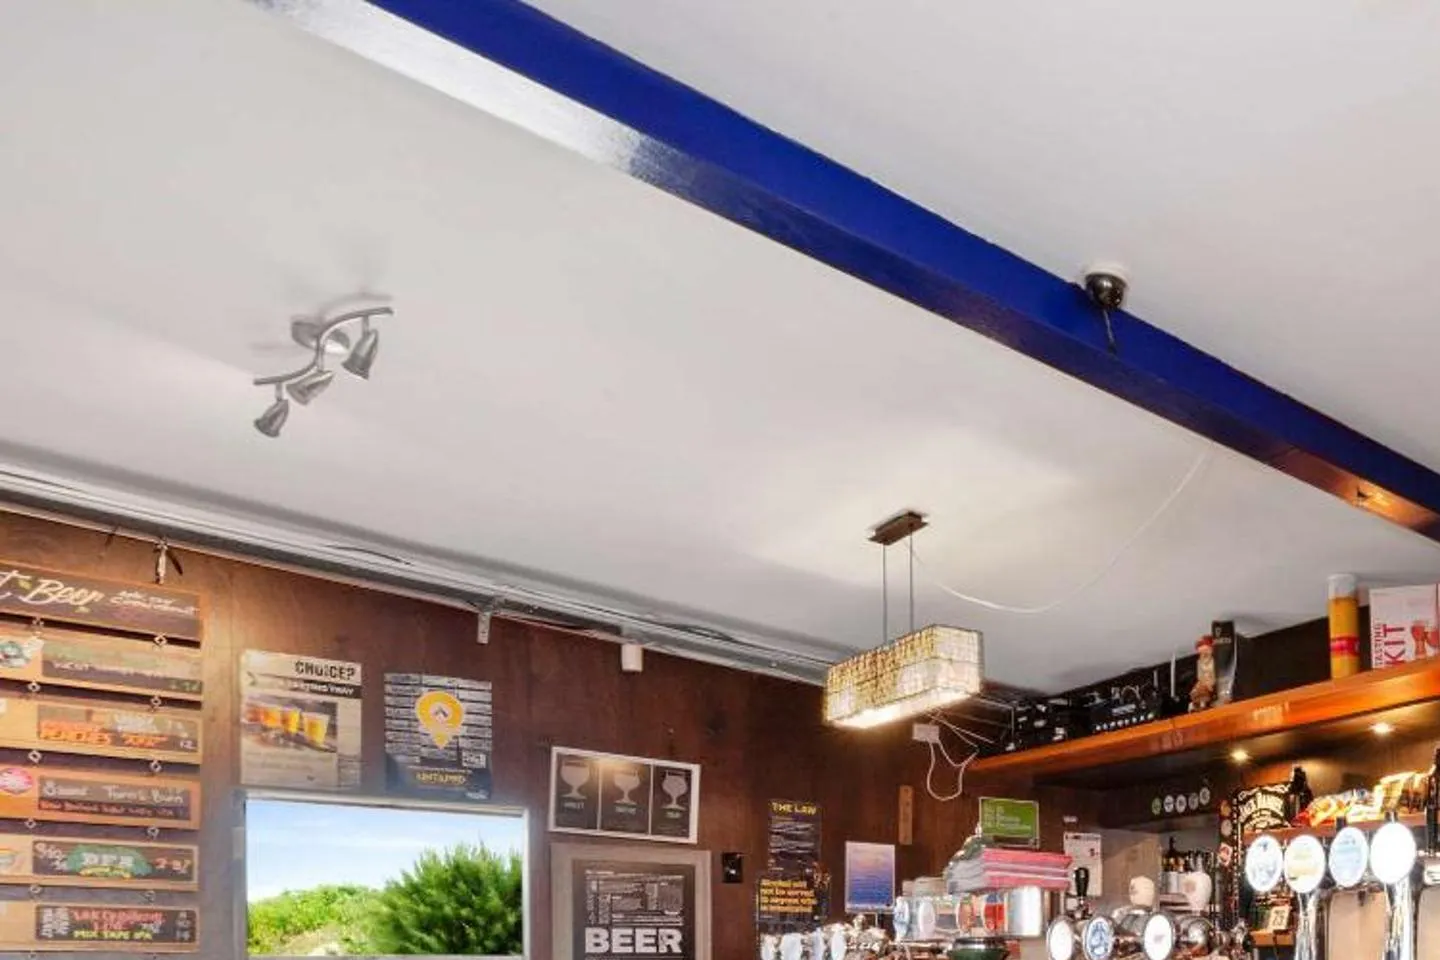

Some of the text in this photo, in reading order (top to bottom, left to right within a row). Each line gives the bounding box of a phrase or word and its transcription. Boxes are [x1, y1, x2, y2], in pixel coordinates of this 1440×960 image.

[1383, 624, 1406, 665] KIT
[771, 802, 794, 812] THE
[585, 927, 682, 953] BEER
